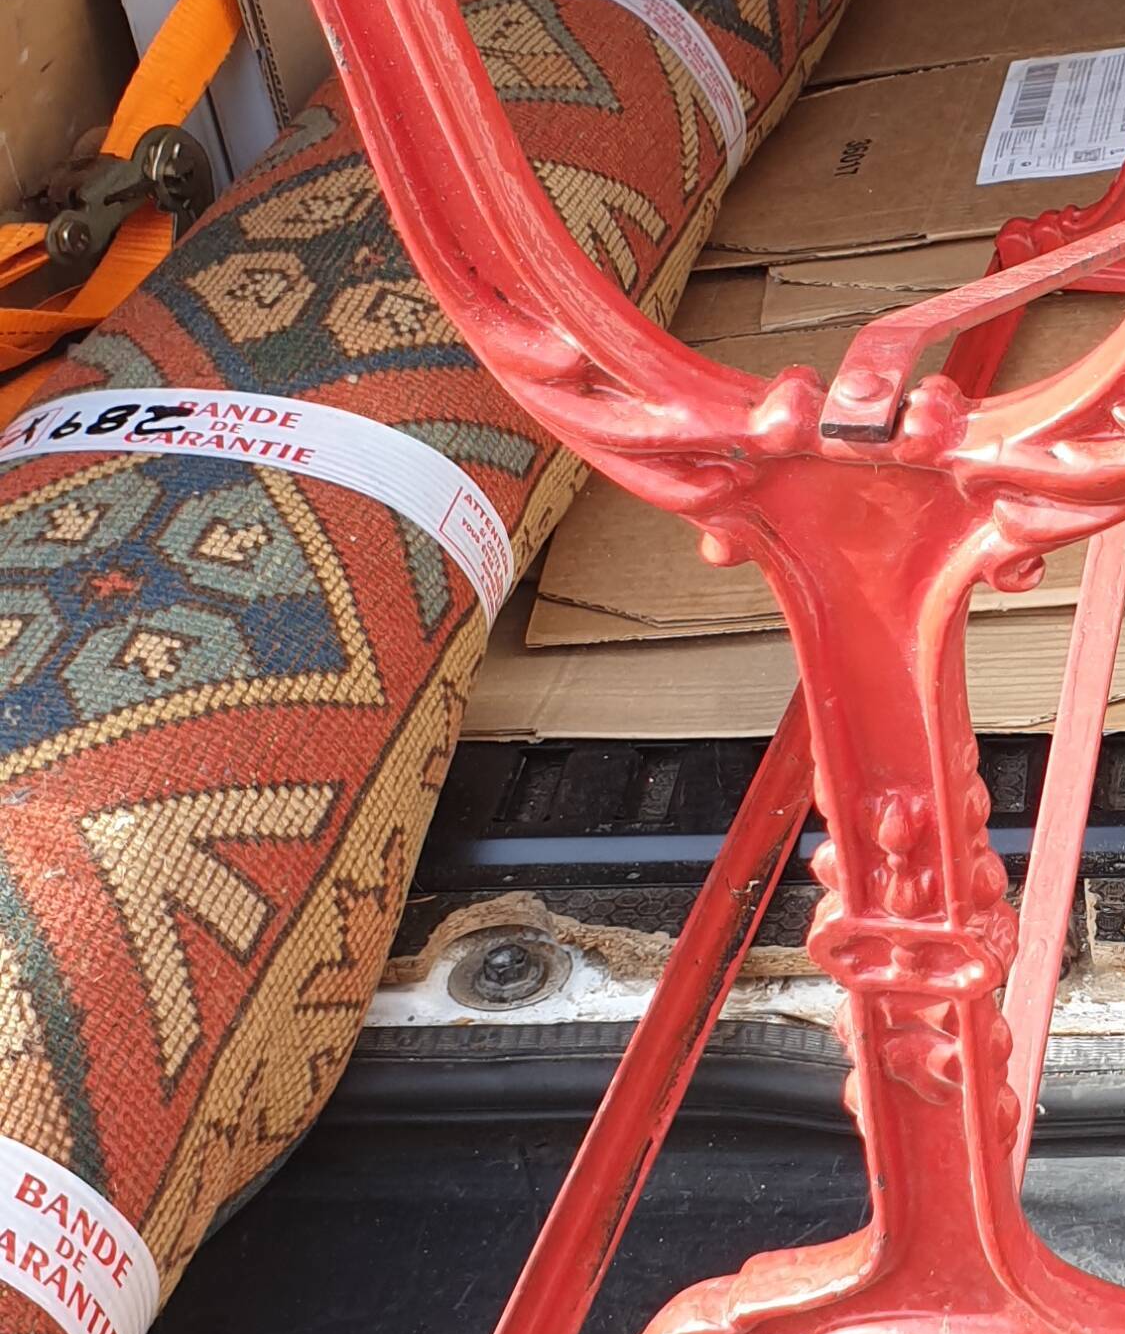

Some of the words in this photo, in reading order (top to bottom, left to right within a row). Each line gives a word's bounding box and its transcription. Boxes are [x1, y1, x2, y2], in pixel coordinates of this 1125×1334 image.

[208, 420, 243, 435] DE
[15, 1171, 134, 1289] BANDE
[55, 1235, 88, 1274] DE
